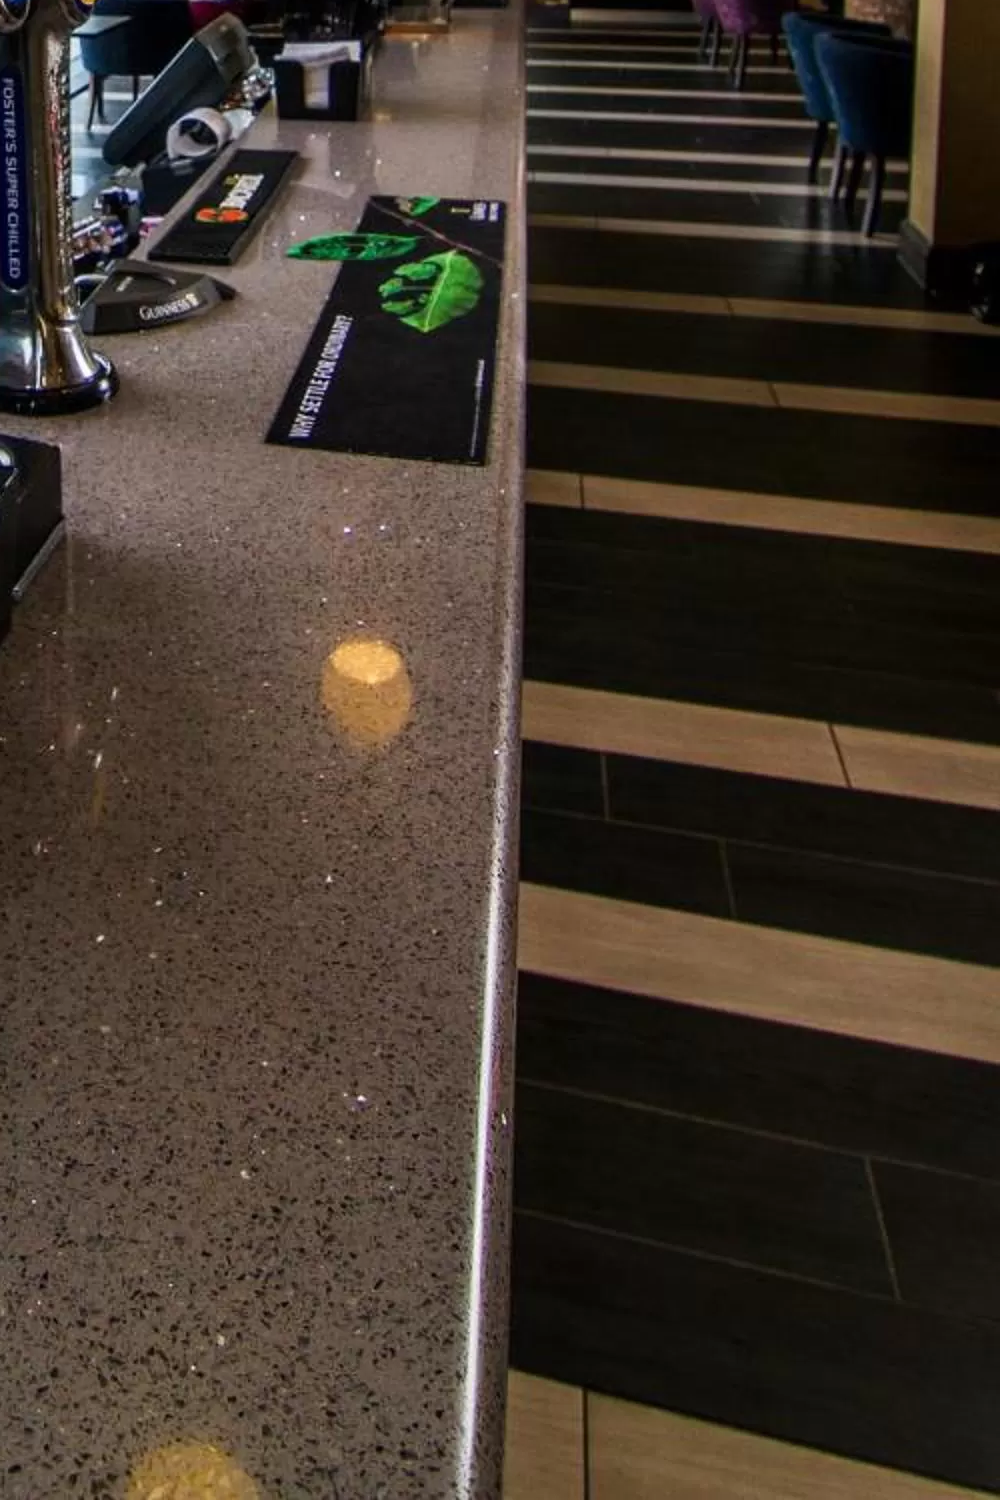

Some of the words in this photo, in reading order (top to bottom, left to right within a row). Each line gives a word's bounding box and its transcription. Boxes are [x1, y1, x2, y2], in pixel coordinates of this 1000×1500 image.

[1, 77, 17, 152] FOSTER'S
[5, 156, 21, 210] SUPER
[6, 211, 22, 280] CHILLED
[312, 359, 337, 379] FOR
[299, 377, 330, 414] SETTLE
[287, 411, 317, 438] WHY
